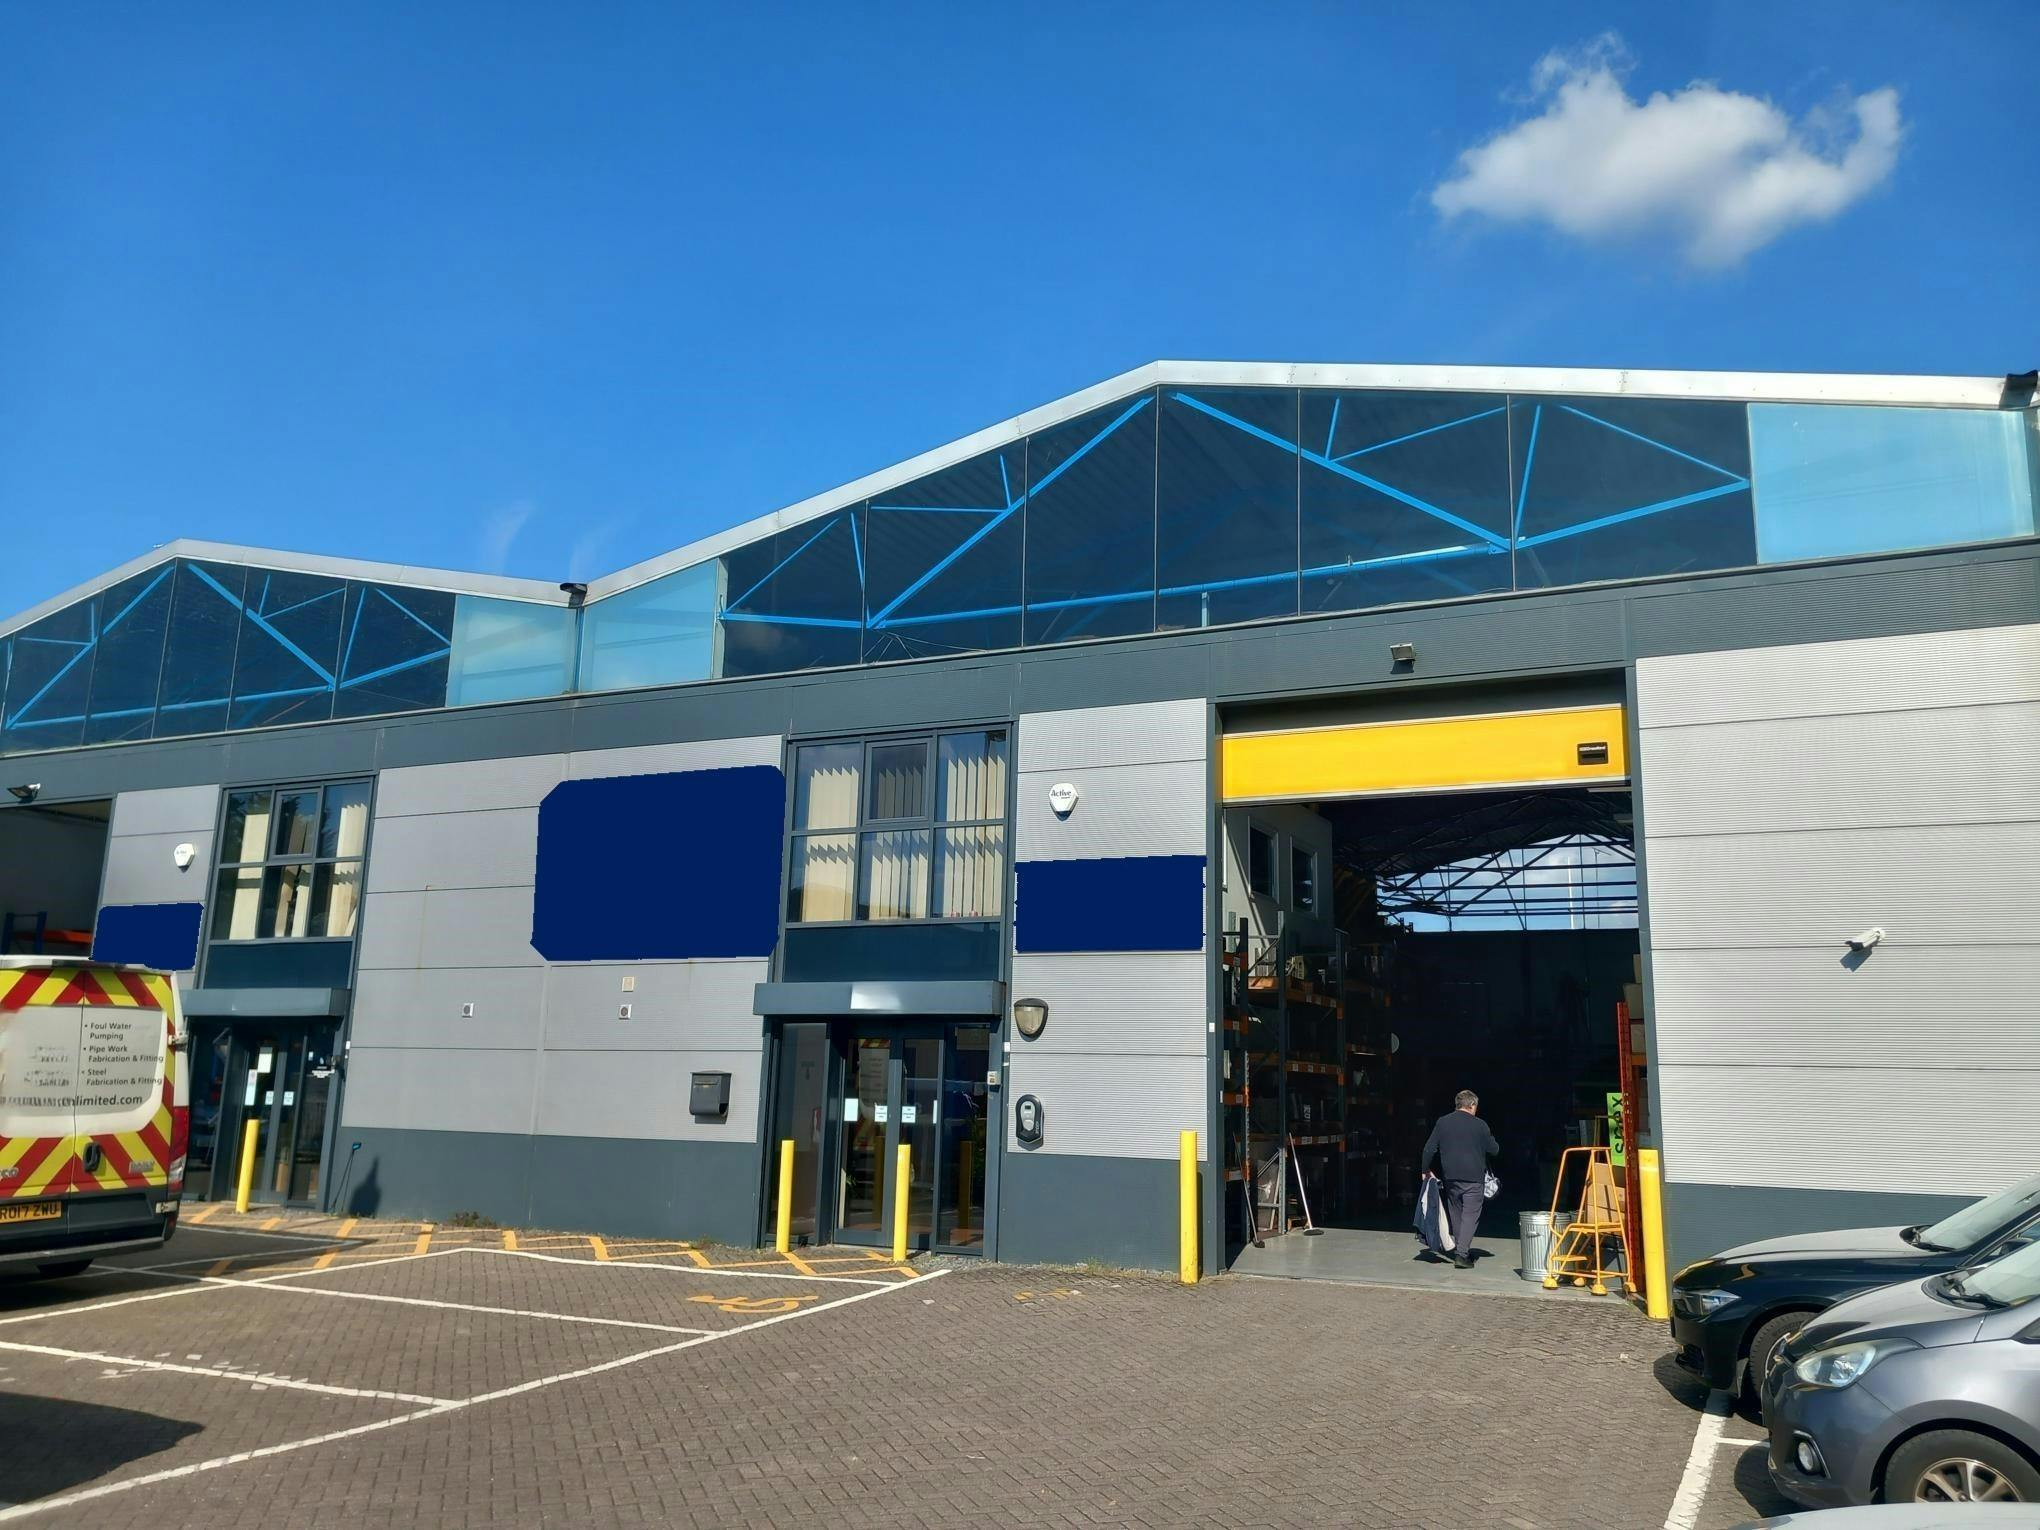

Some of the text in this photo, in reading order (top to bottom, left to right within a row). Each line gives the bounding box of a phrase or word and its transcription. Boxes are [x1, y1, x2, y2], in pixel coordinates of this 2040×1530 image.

[90, 1022, 132, 1030] Foul Water
[89, 1032, 124, 1041] Pumping
[89, 1045, 128, 1053] Pipe Work
[88, 1055, 131, 1063] Fabrication
[139, 1054, 164, 1064] Fitting
[87, 1067, 107, 1076] Steel
[86, 1076, 163, 1086] Fabrication & Fitting
